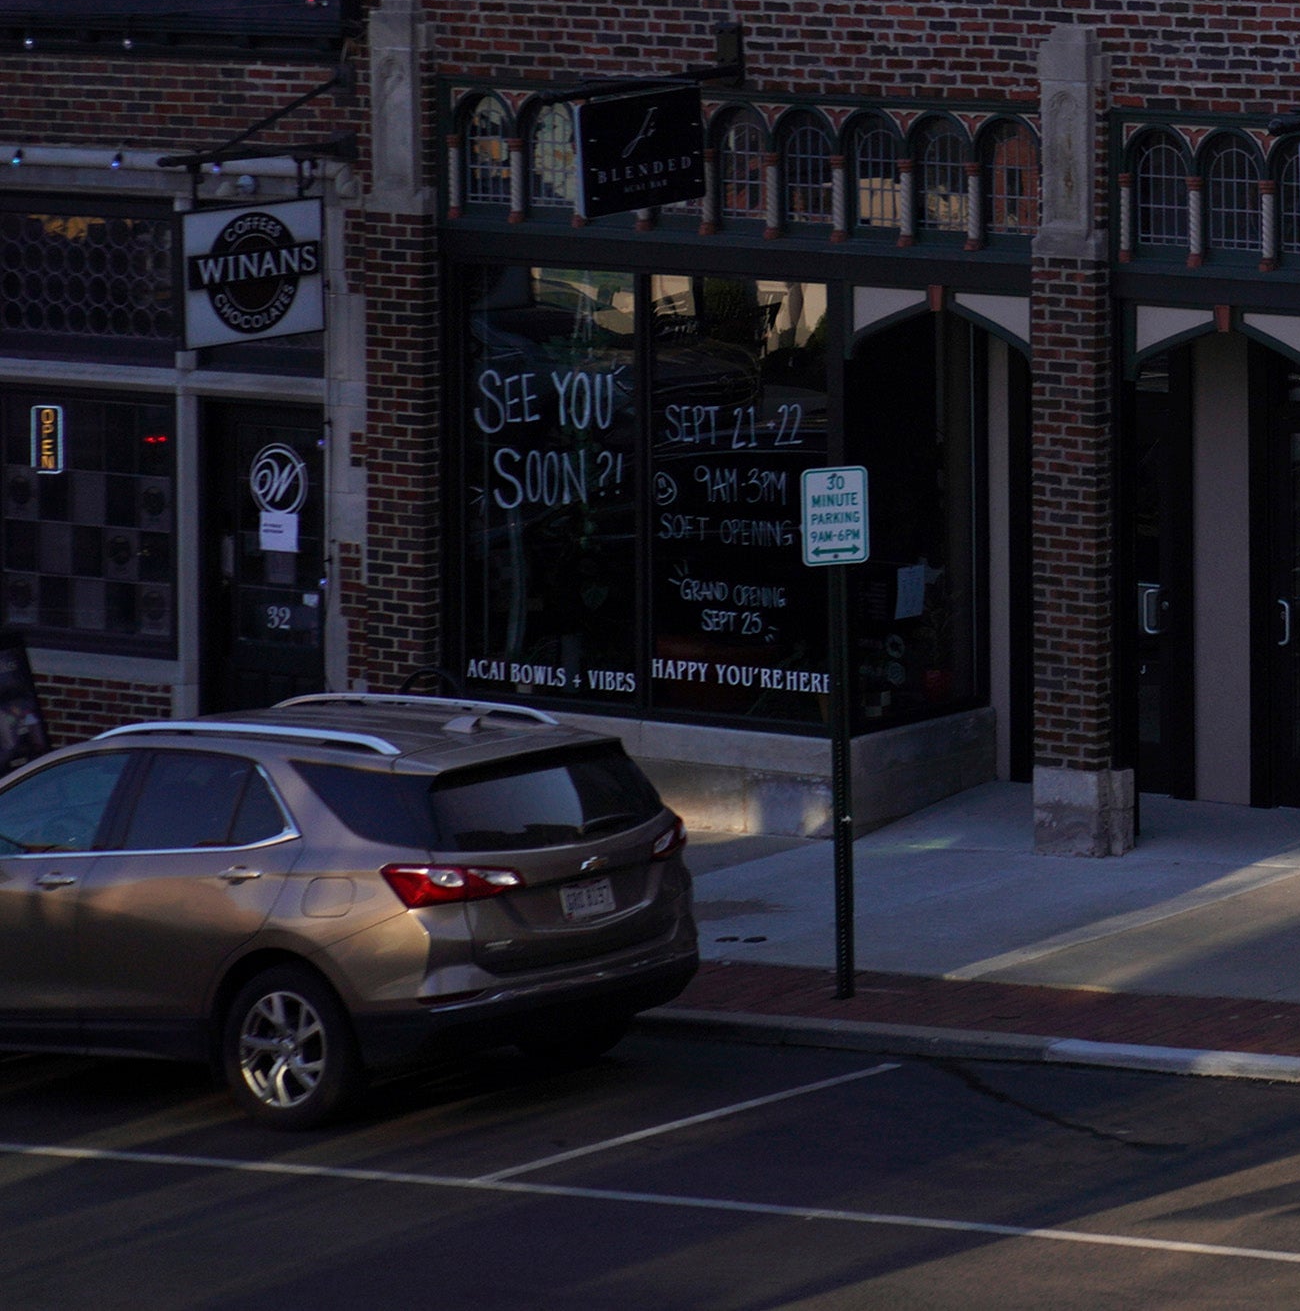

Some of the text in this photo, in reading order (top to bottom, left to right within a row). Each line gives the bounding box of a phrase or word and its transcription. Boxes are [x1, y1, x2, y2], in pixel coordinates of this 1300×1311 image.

[597, 156, 692, 185] BLENDED
[223, 215, 283, 243] COFFEES
[196, 244, 317, 286] WINANS
[213, 284, 296, 330] CHOCOLATES
[474, 369, 613, 434] SEE YOU
[40, 408, 56, 470] OPEN
[664, 403, 720, 446] SEPT
[731, 405, 758, 449] 21
[773, 403, 804, 447] 22
[492, 447, 588, 509] SOON
[826, 474, 846, 491] 30
[811, 491, 859, 508] MINUTE
[658, 512, 794, 546] SOFT OPENING
[810, 511, 861, 526] PARKING
[810, 528, 861, 544] 9AM-6PM
[679, 577, 787, 608] GRAND OPENING
[266, 605, 291, 629] 32
[700, 608, 763, 635] SEPT 25
[465, 657, 637, 693] ACAI BOWLS + VIBES
[651, 657, 708, 682] HAPPY
[714, 663, 786, 689] YOU'RE
